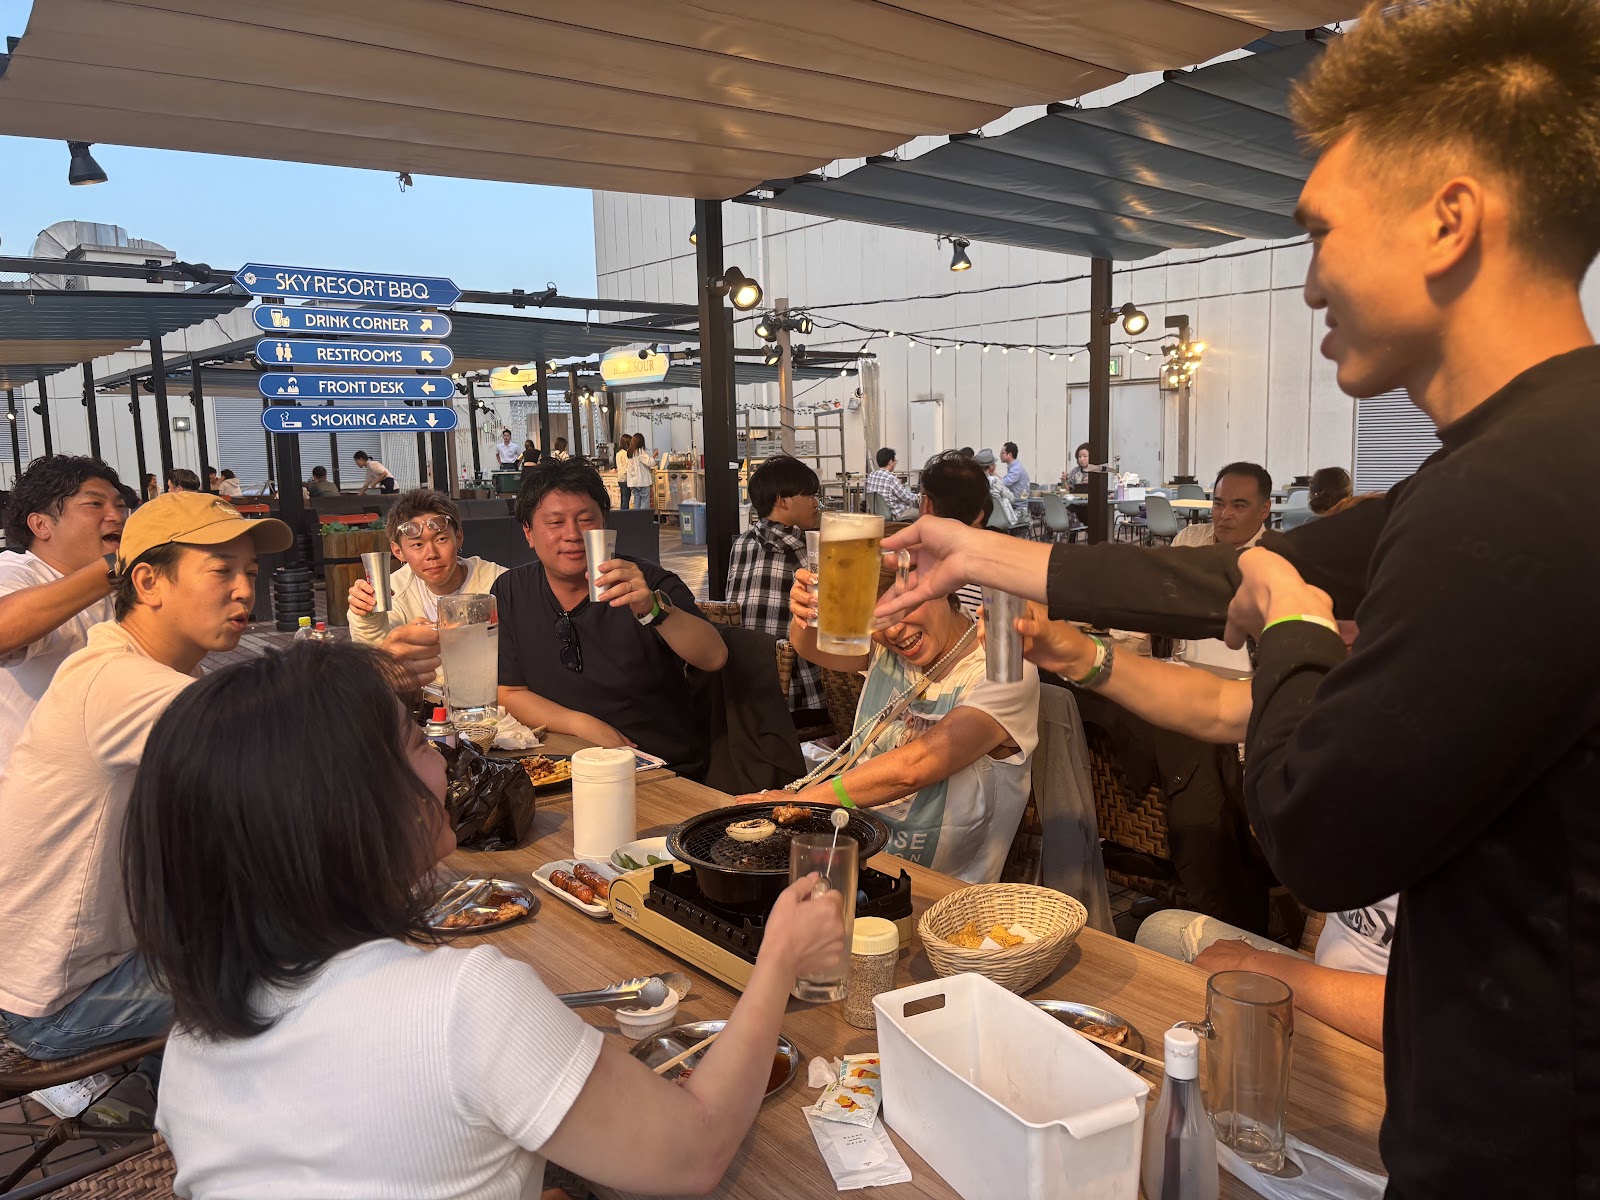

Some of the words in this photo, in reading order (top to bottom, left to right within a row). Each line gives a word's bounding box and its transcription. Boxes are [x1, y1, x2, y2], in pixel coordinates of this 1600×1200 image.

[275, 272, 312, 292] SKY
[314, 275, 386, 297] RESORT
[388, 281, 430, 299] BBQ
[305, 313, 350, 329] DRINK
[352, 316, 409, 331] CORNER
[316, 347, 403, 362] RESTROOMS
[632, 359, 655, 373] SOUR
[318, 380, 367, 394] FRONT
[369, 381, 405, 394] DESK
[310, 413, 377, 426] SMOKING
[379, 413, 418, 426] AREA
